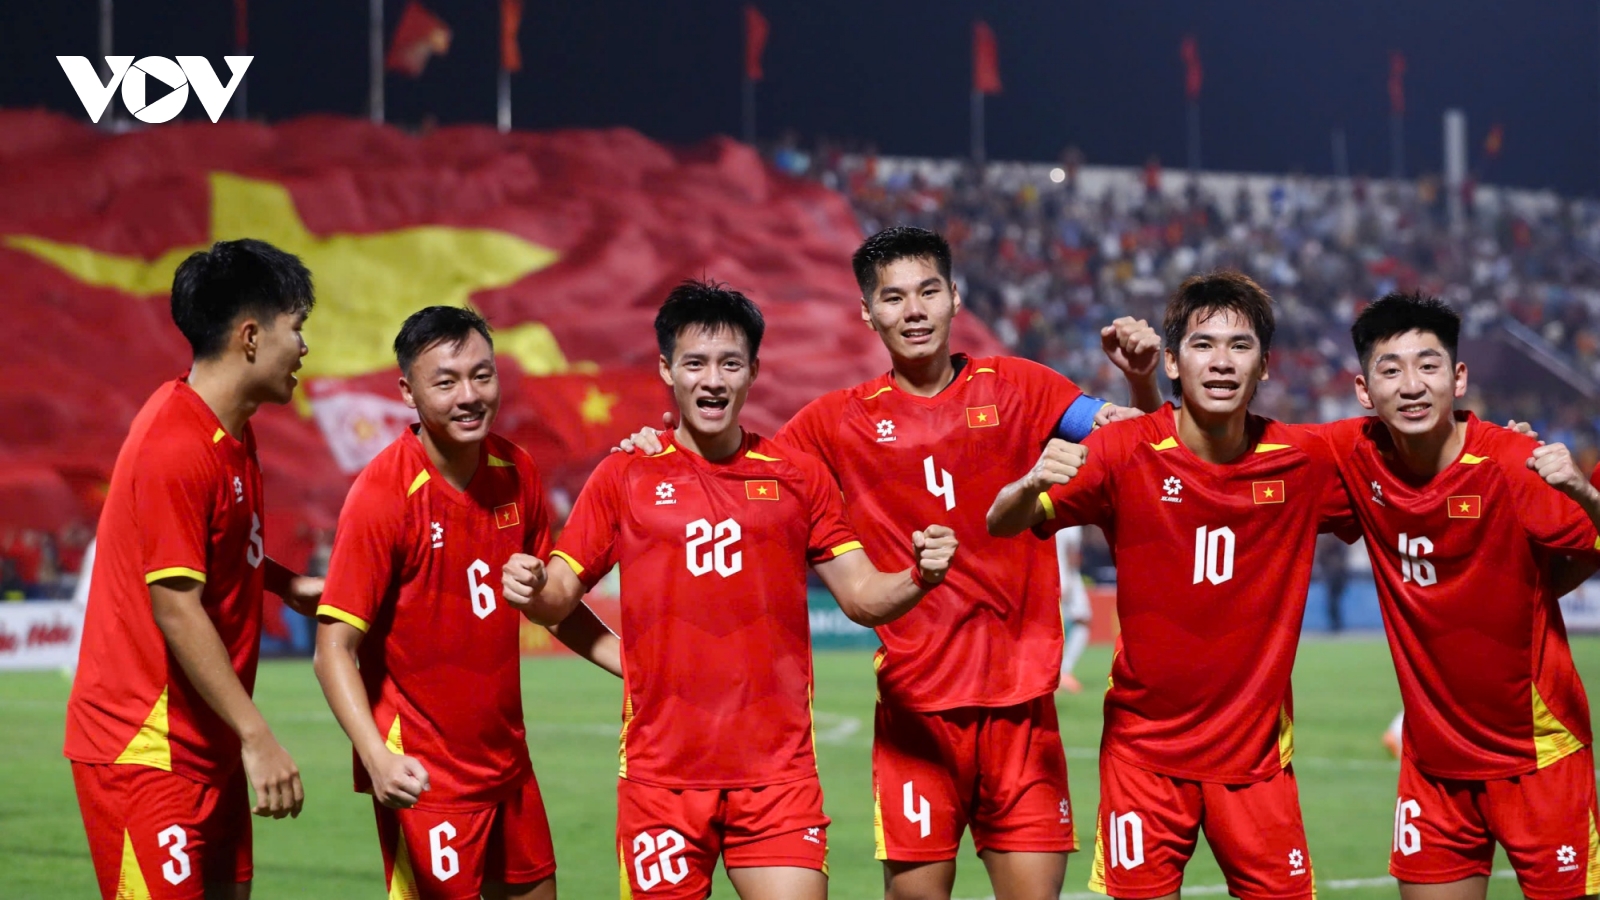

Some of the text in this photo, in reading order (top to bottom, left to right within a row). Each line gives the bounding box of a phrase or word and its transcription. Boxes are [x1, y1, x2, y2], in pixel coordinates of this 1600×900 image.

[923, 455, 956, 512] 4
[685, 517, 743, 578] 22
[1192, 525, 1236, 586] 10
[1397, 532, 1438, 588] 16
[466, 558, 498, 620] 6
[902, 780, 932, 838] 4
[1393, 796, 1422, 857] 16
[157, 824, 191, 886] 3
[428, 820, 460, 882] 6
[632, 828, 690, 892] 22
[1109, 810, 1145, 871] 10
